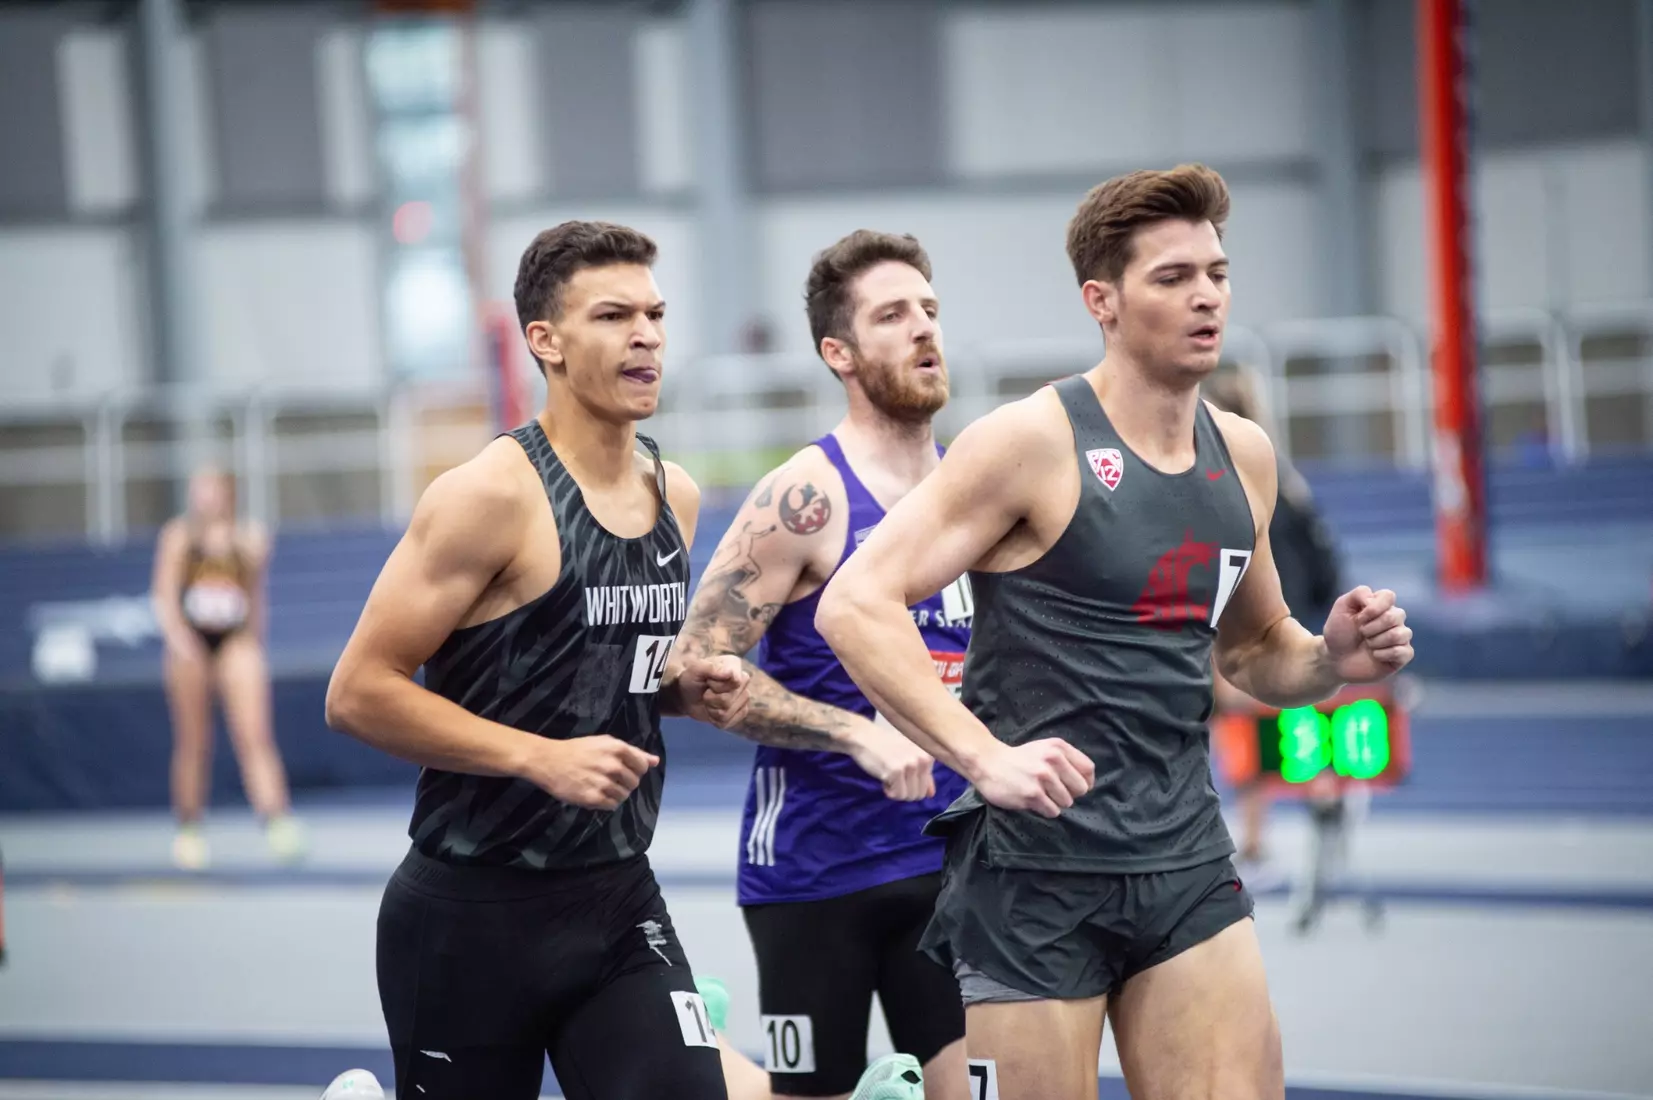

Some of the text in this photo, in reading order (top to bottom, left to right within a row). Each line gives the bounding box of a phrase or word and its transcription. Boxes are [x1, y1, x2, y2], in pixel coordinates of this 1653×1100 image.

[1100, 465, 1118, 481] 12
[1229, 555, 1248, 602] 7
[585, 582, 685, 626] WHITWORTH
[645, 639, 673, 690] 14
[766, 1019, 801, 1069] 10
[968, 1064, 988, 1100] 7
